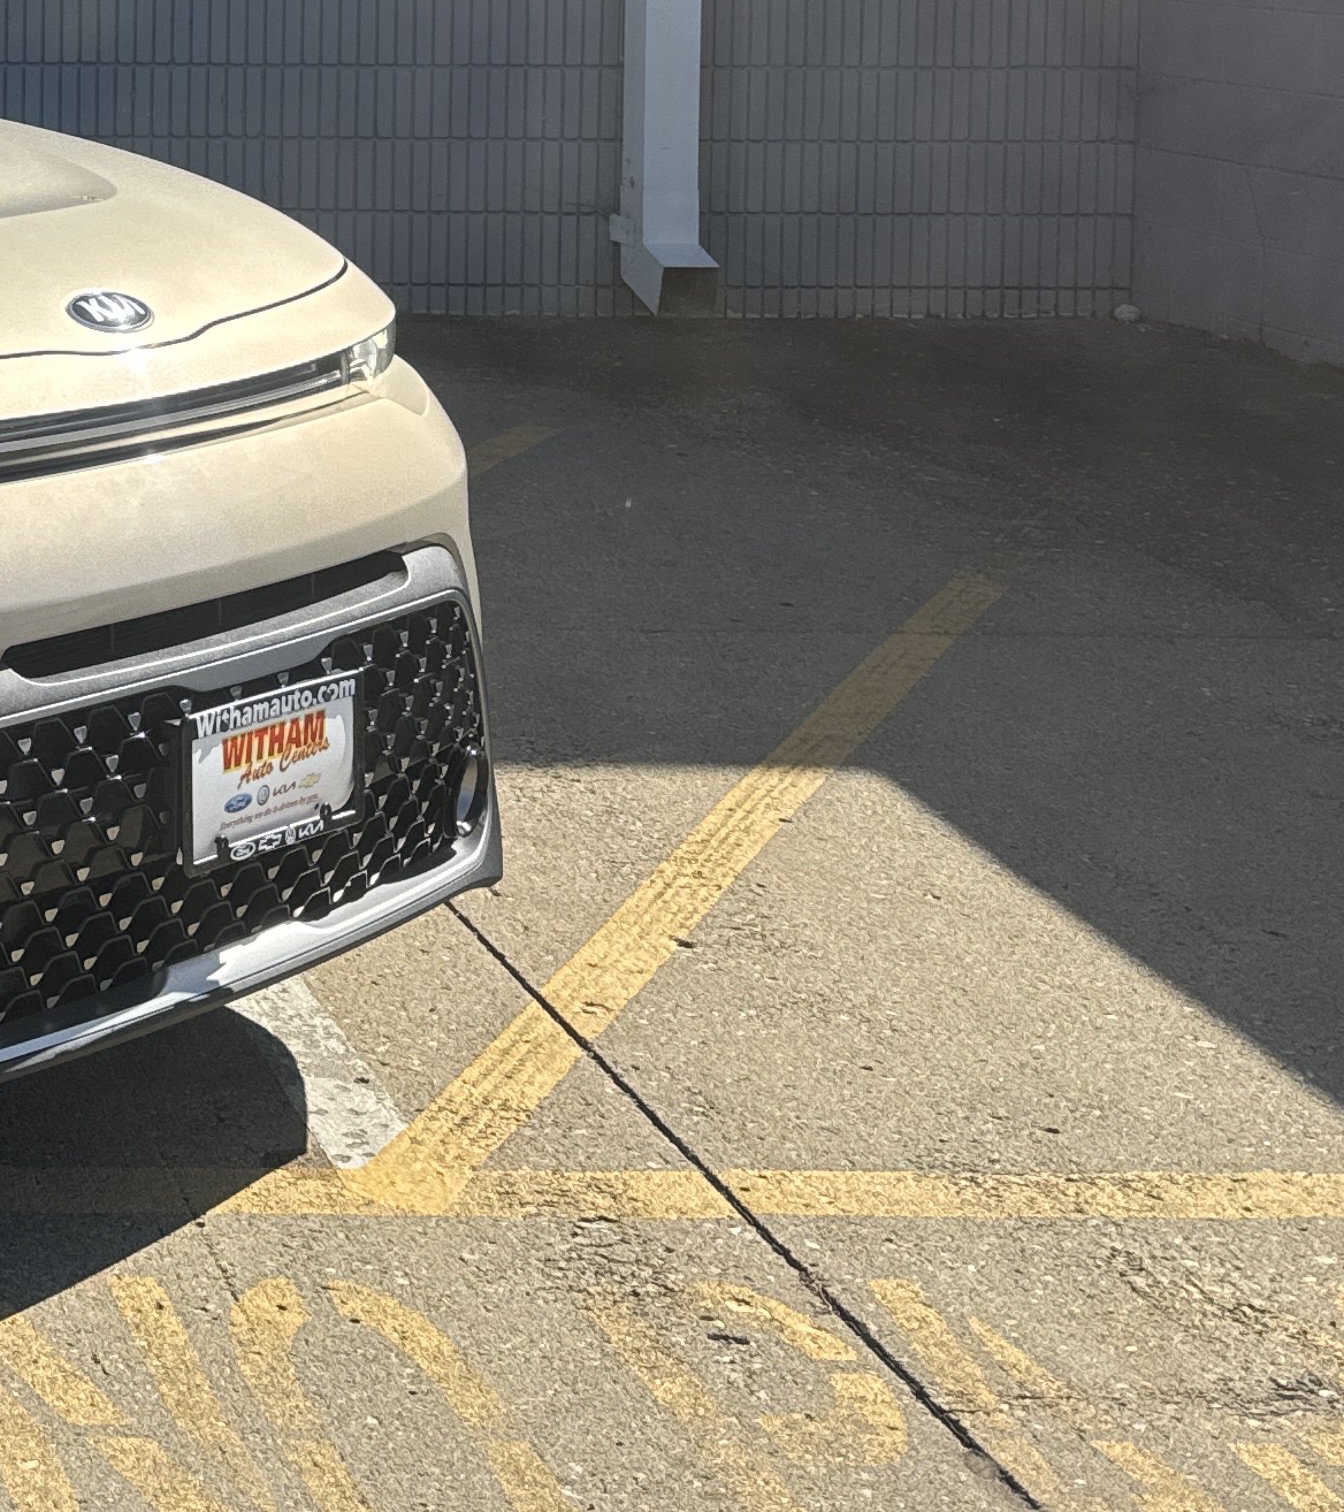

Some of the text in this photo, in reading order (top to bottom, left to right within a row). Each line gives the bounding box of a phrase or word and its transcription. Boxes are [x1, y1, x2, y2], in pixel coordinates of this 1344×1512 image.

[195, 678, 356, 739] Withamauto.com
[221, 708, 327, 775] WITHAM
[237, 736, 331, 790] Auto Centers
